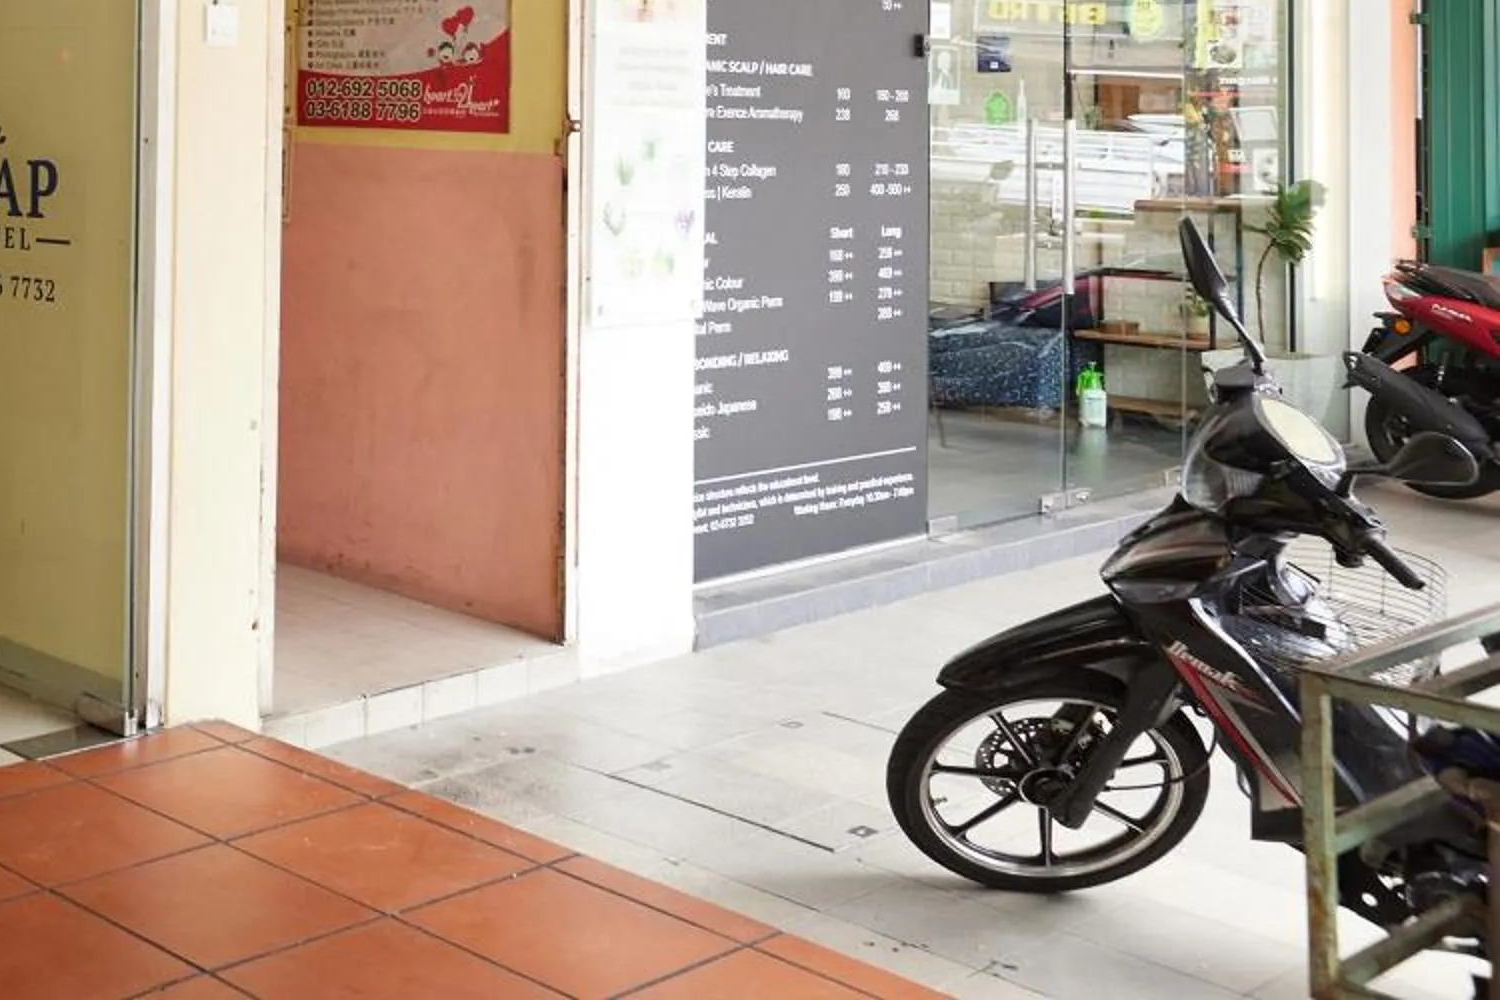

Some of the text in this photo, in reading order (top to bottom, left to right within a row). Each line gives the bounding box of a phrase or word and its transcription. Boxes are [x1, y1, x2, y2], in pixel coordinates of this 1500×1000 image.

[728, 61, 758, 74] SCALP
[307, 78, 422, 98] 012-692 5068
[307, 101, 372, 119] 03-6188
[375, 101, 420, 121] 7796
[10, 275, 56, 302] 7732
